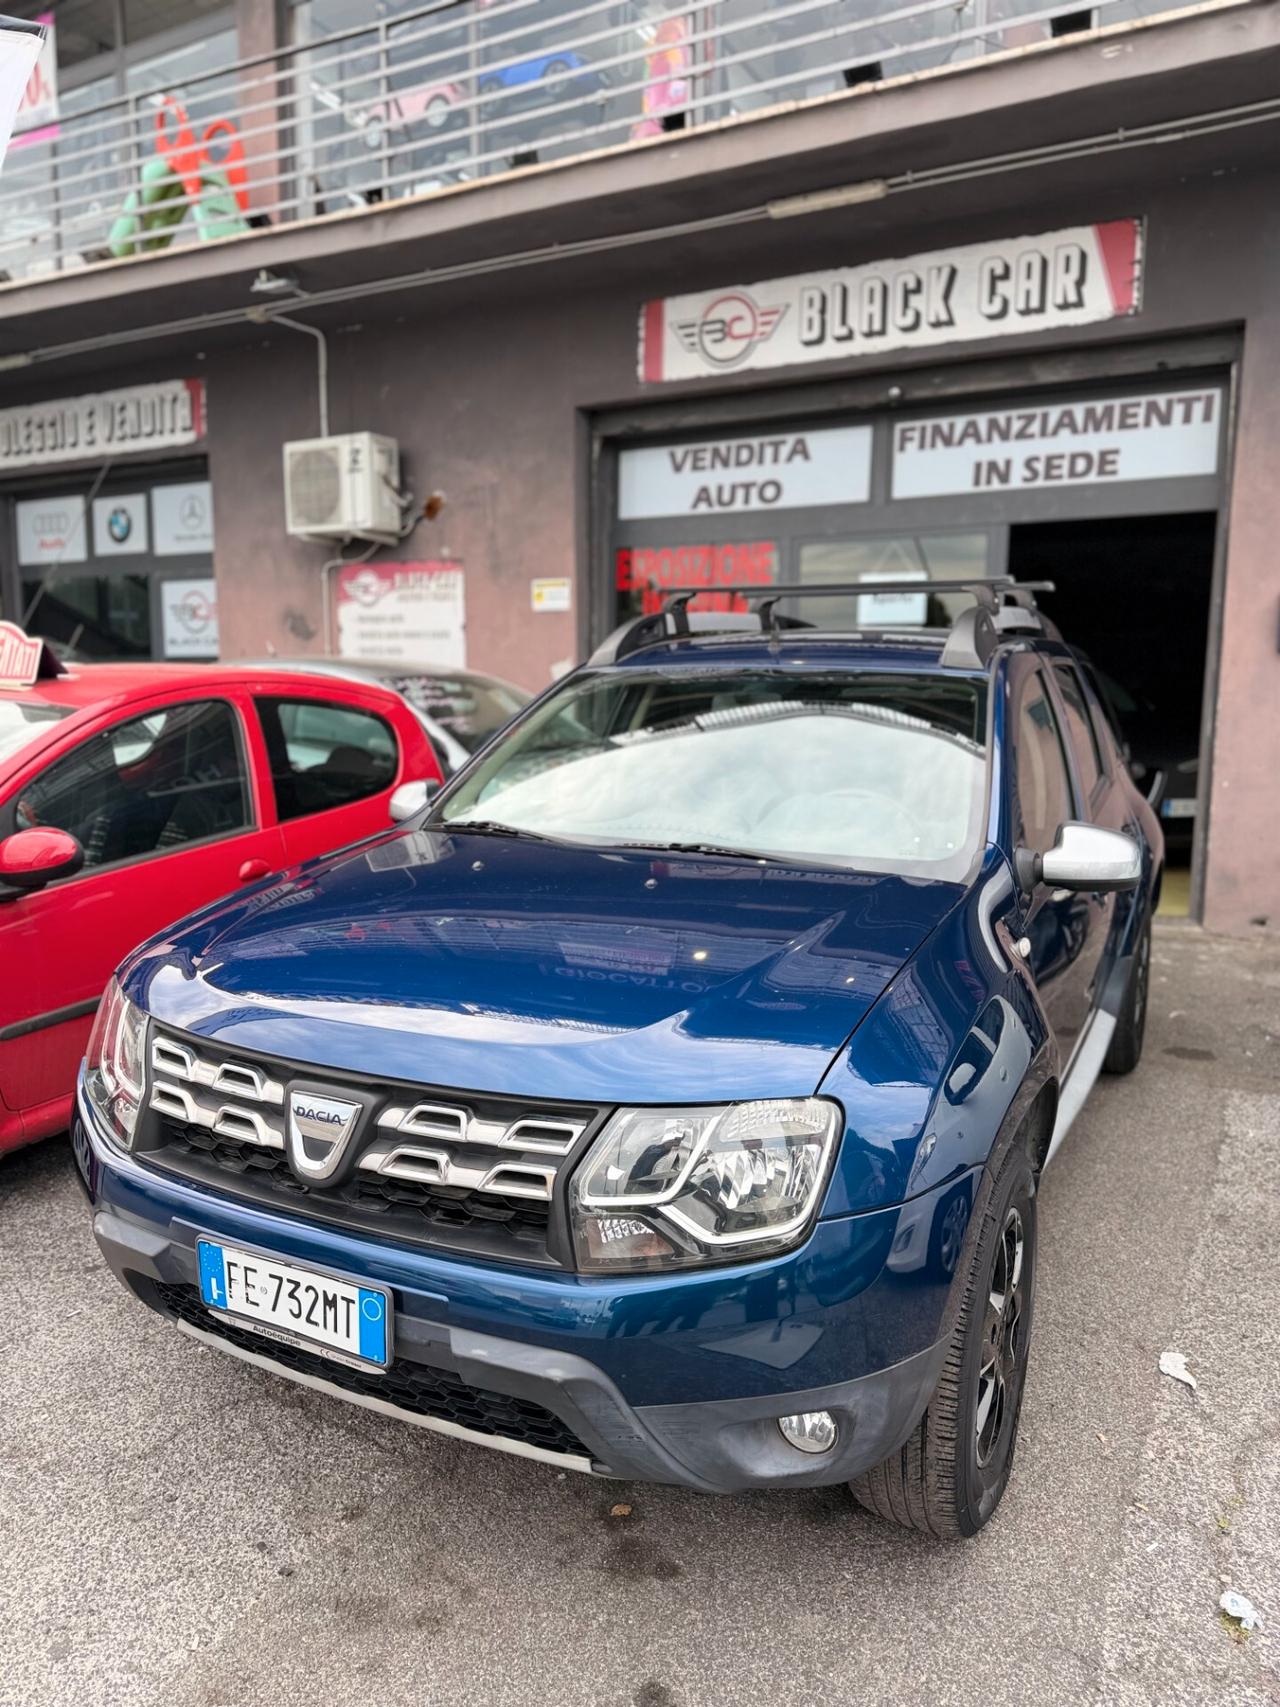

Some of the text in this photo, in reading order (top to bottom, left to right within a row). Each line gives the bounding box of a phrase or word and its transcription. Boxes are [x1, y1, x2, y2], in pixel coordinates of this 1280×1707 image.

[800, 243, 1087, 346] BLACK CAR
[899, 394, 1215, 452] FINANZIAMENTI
[669, 437, 811, 473] VENDITA
[973, 449, 1120, 486] IN SEDE
[692, 480, 783, 510] AUTO
[296, 1106, 341, 1125] DACIA
